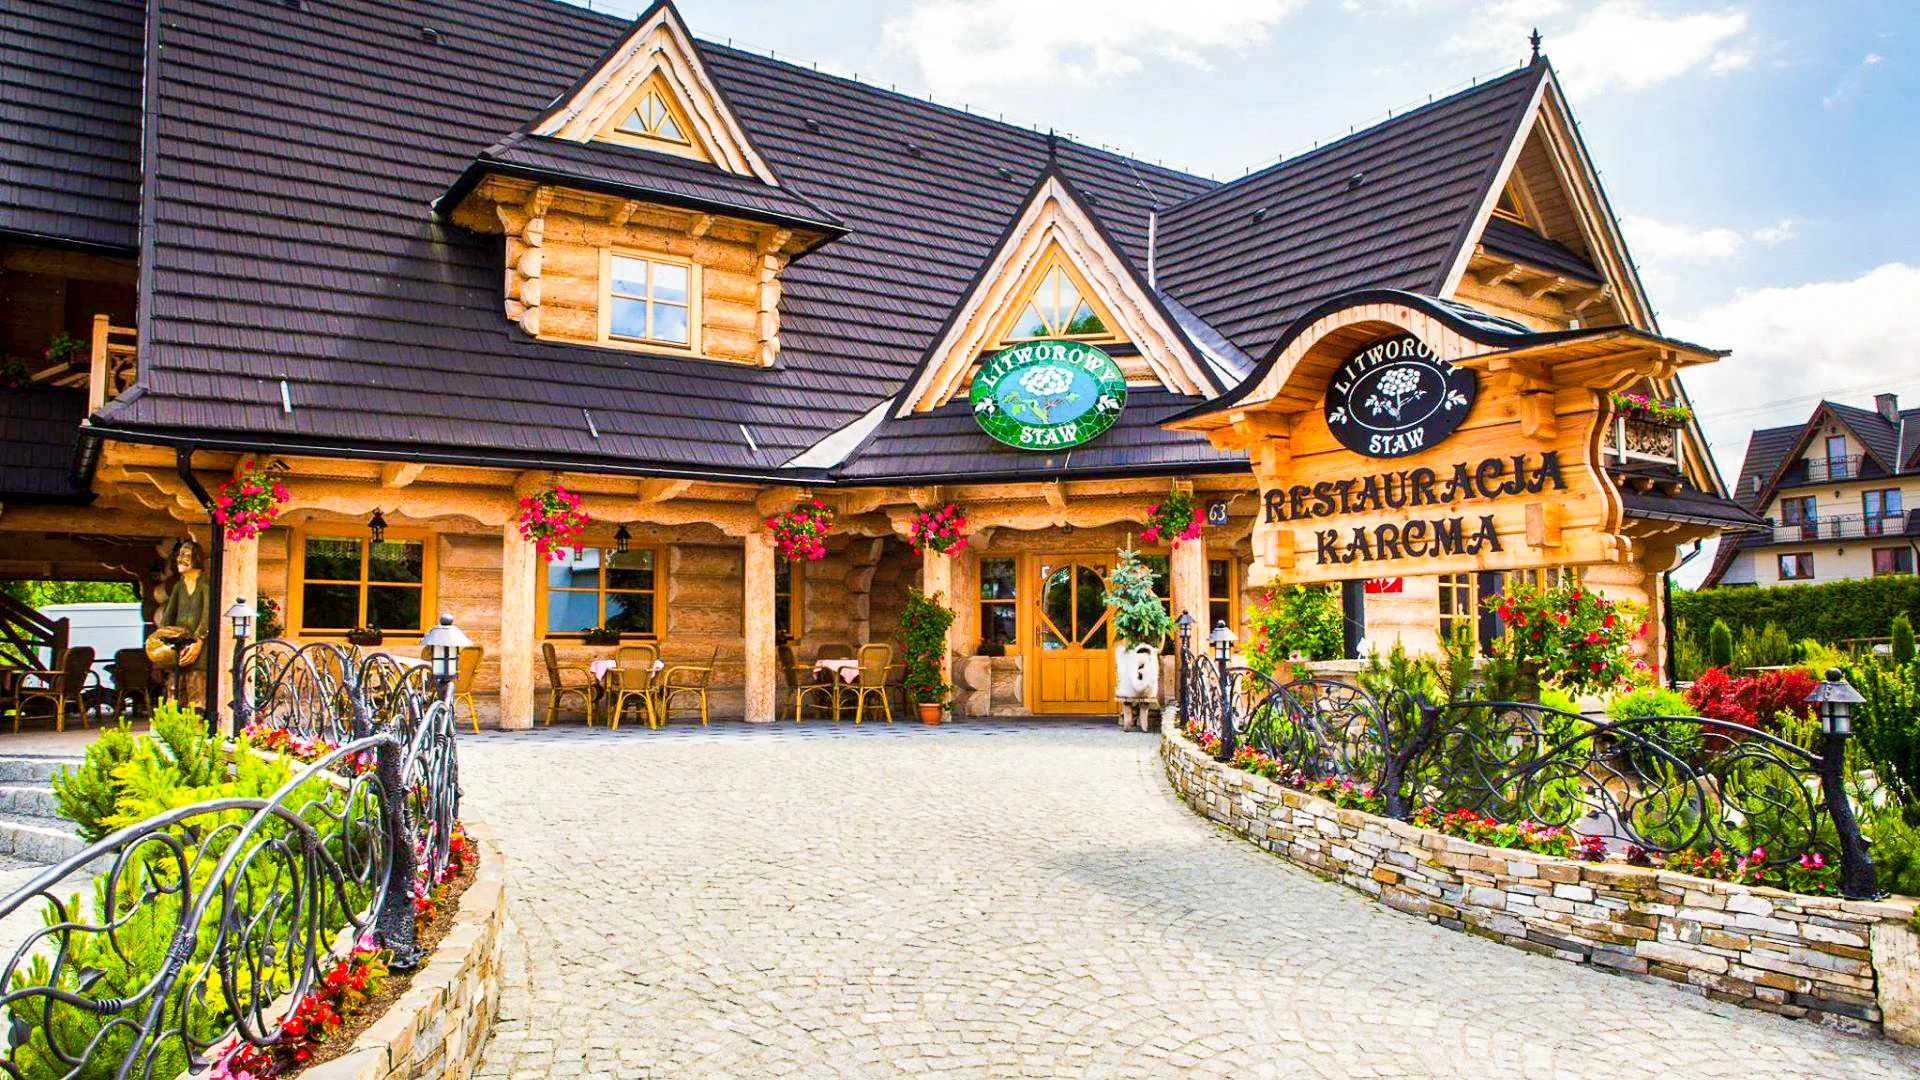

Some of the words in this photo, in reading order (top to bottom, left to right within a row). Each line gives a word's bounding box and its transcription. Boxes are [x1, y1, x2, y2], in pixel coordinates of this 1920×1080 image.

[981, 344, 1116, 389] LITWOROWY
[1020, 423, 1077, 445] STAW
[1369, 427, 1425, 454] STAW
[1264, 450, 1568, 523] RESTAURACJA
[1209, 504, 1226, 520] 63
[1314, 514, 1504, 565] KARCMA
